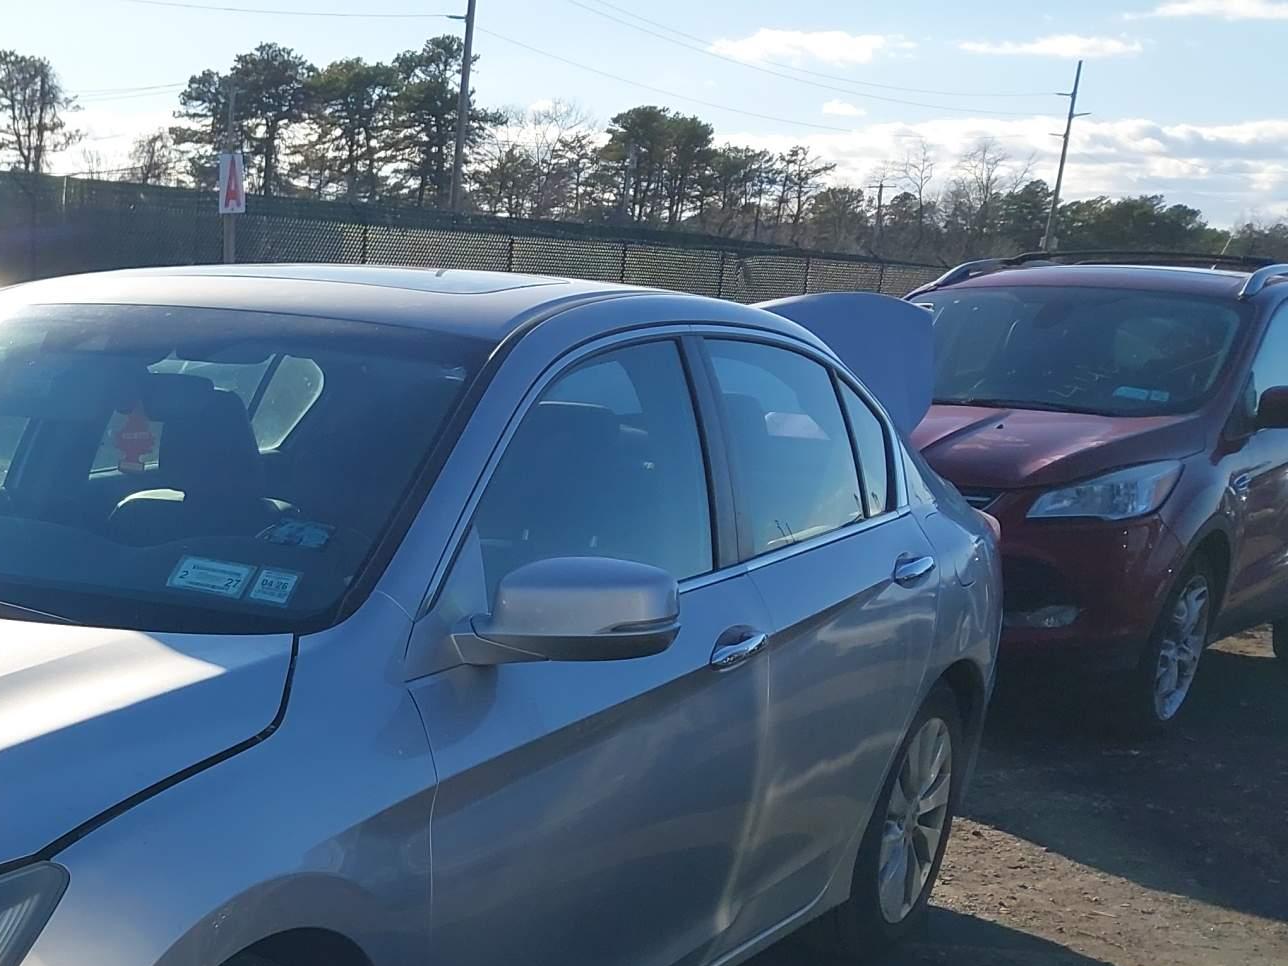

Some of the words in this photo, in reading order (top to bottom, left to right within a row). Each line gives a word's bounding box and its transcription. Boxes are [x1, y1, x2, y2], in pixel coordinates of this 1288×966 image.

[224, 155, 241, 208] A
[178, 570, 189, 579] 2
[224, 577, 241, 588] 27
